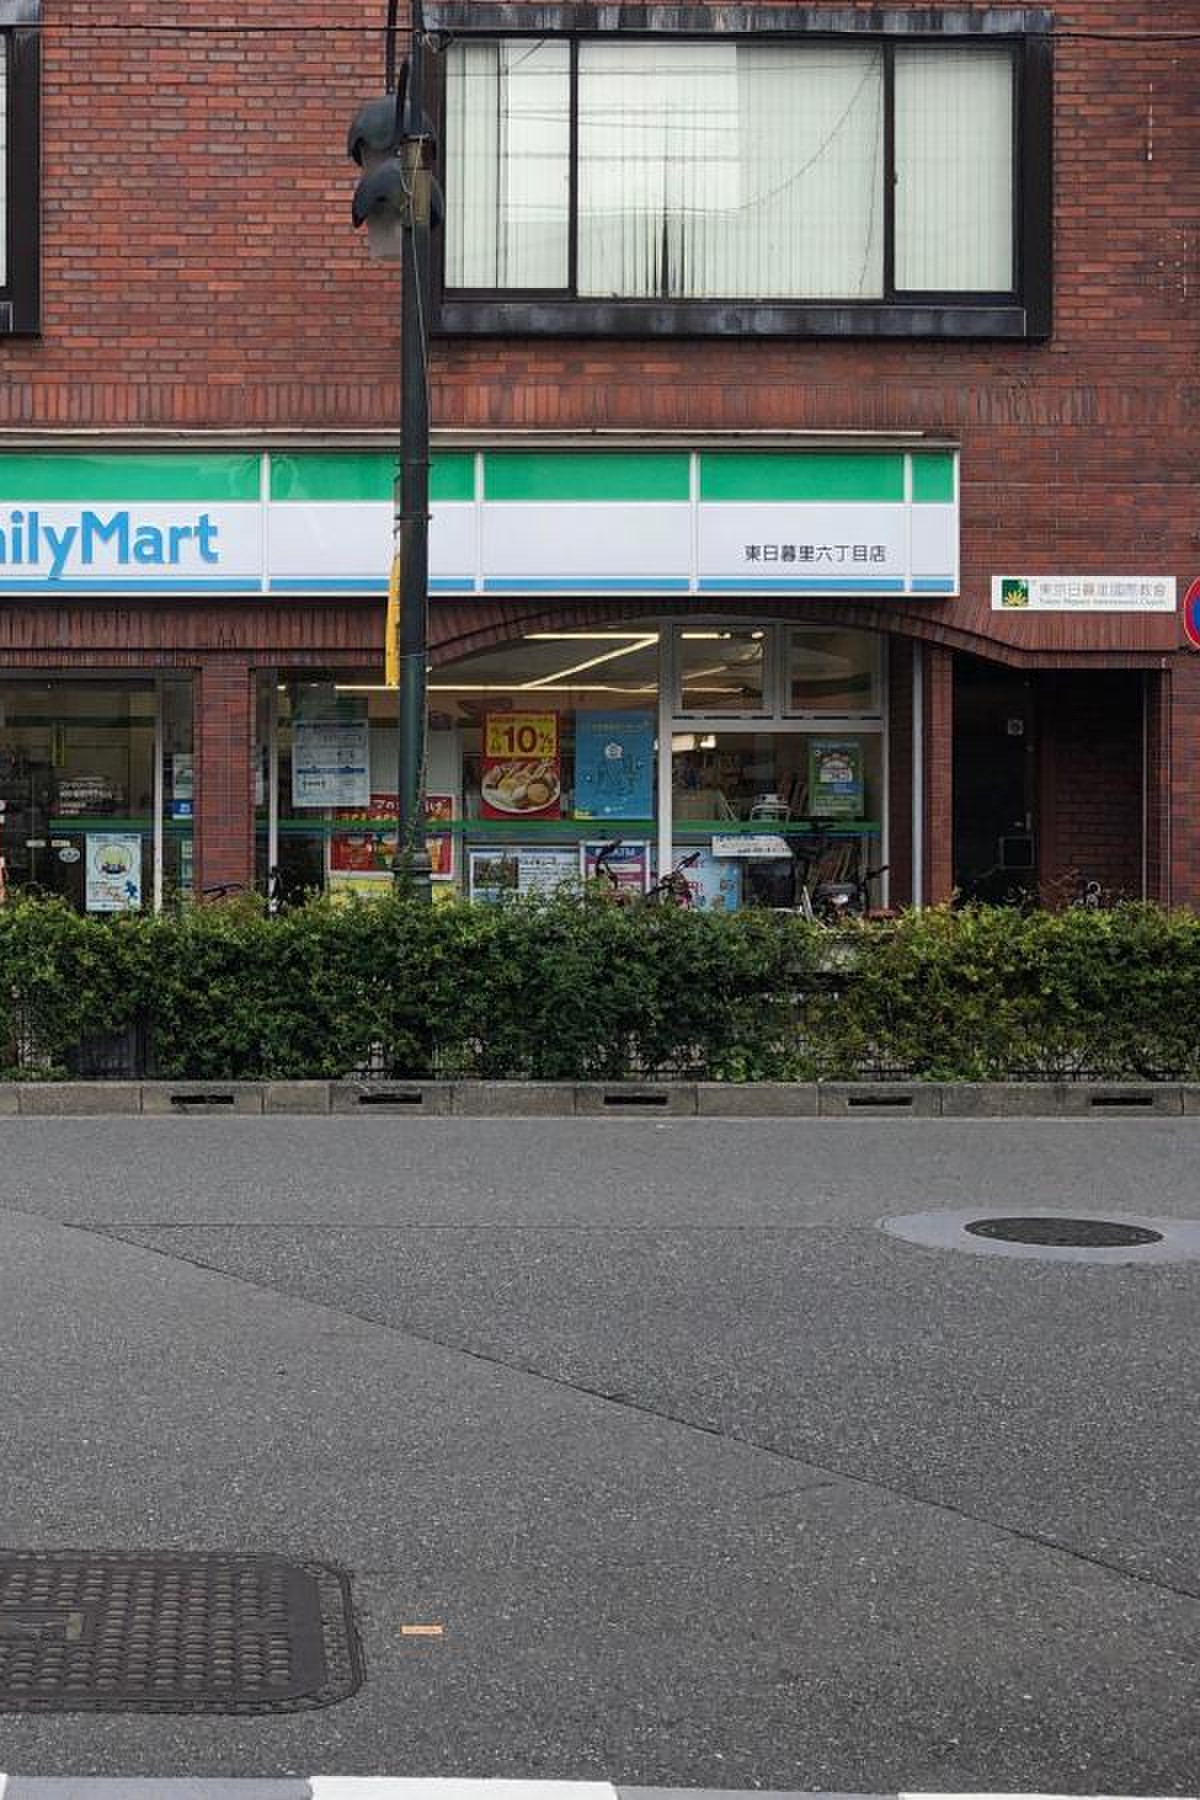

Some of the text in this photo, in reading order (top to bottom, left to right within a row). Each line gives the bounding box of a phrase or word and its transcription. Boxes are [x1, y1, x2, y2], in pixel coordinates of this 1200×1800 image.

[745, 544, 886, 563] 東日暮里六丁目店
